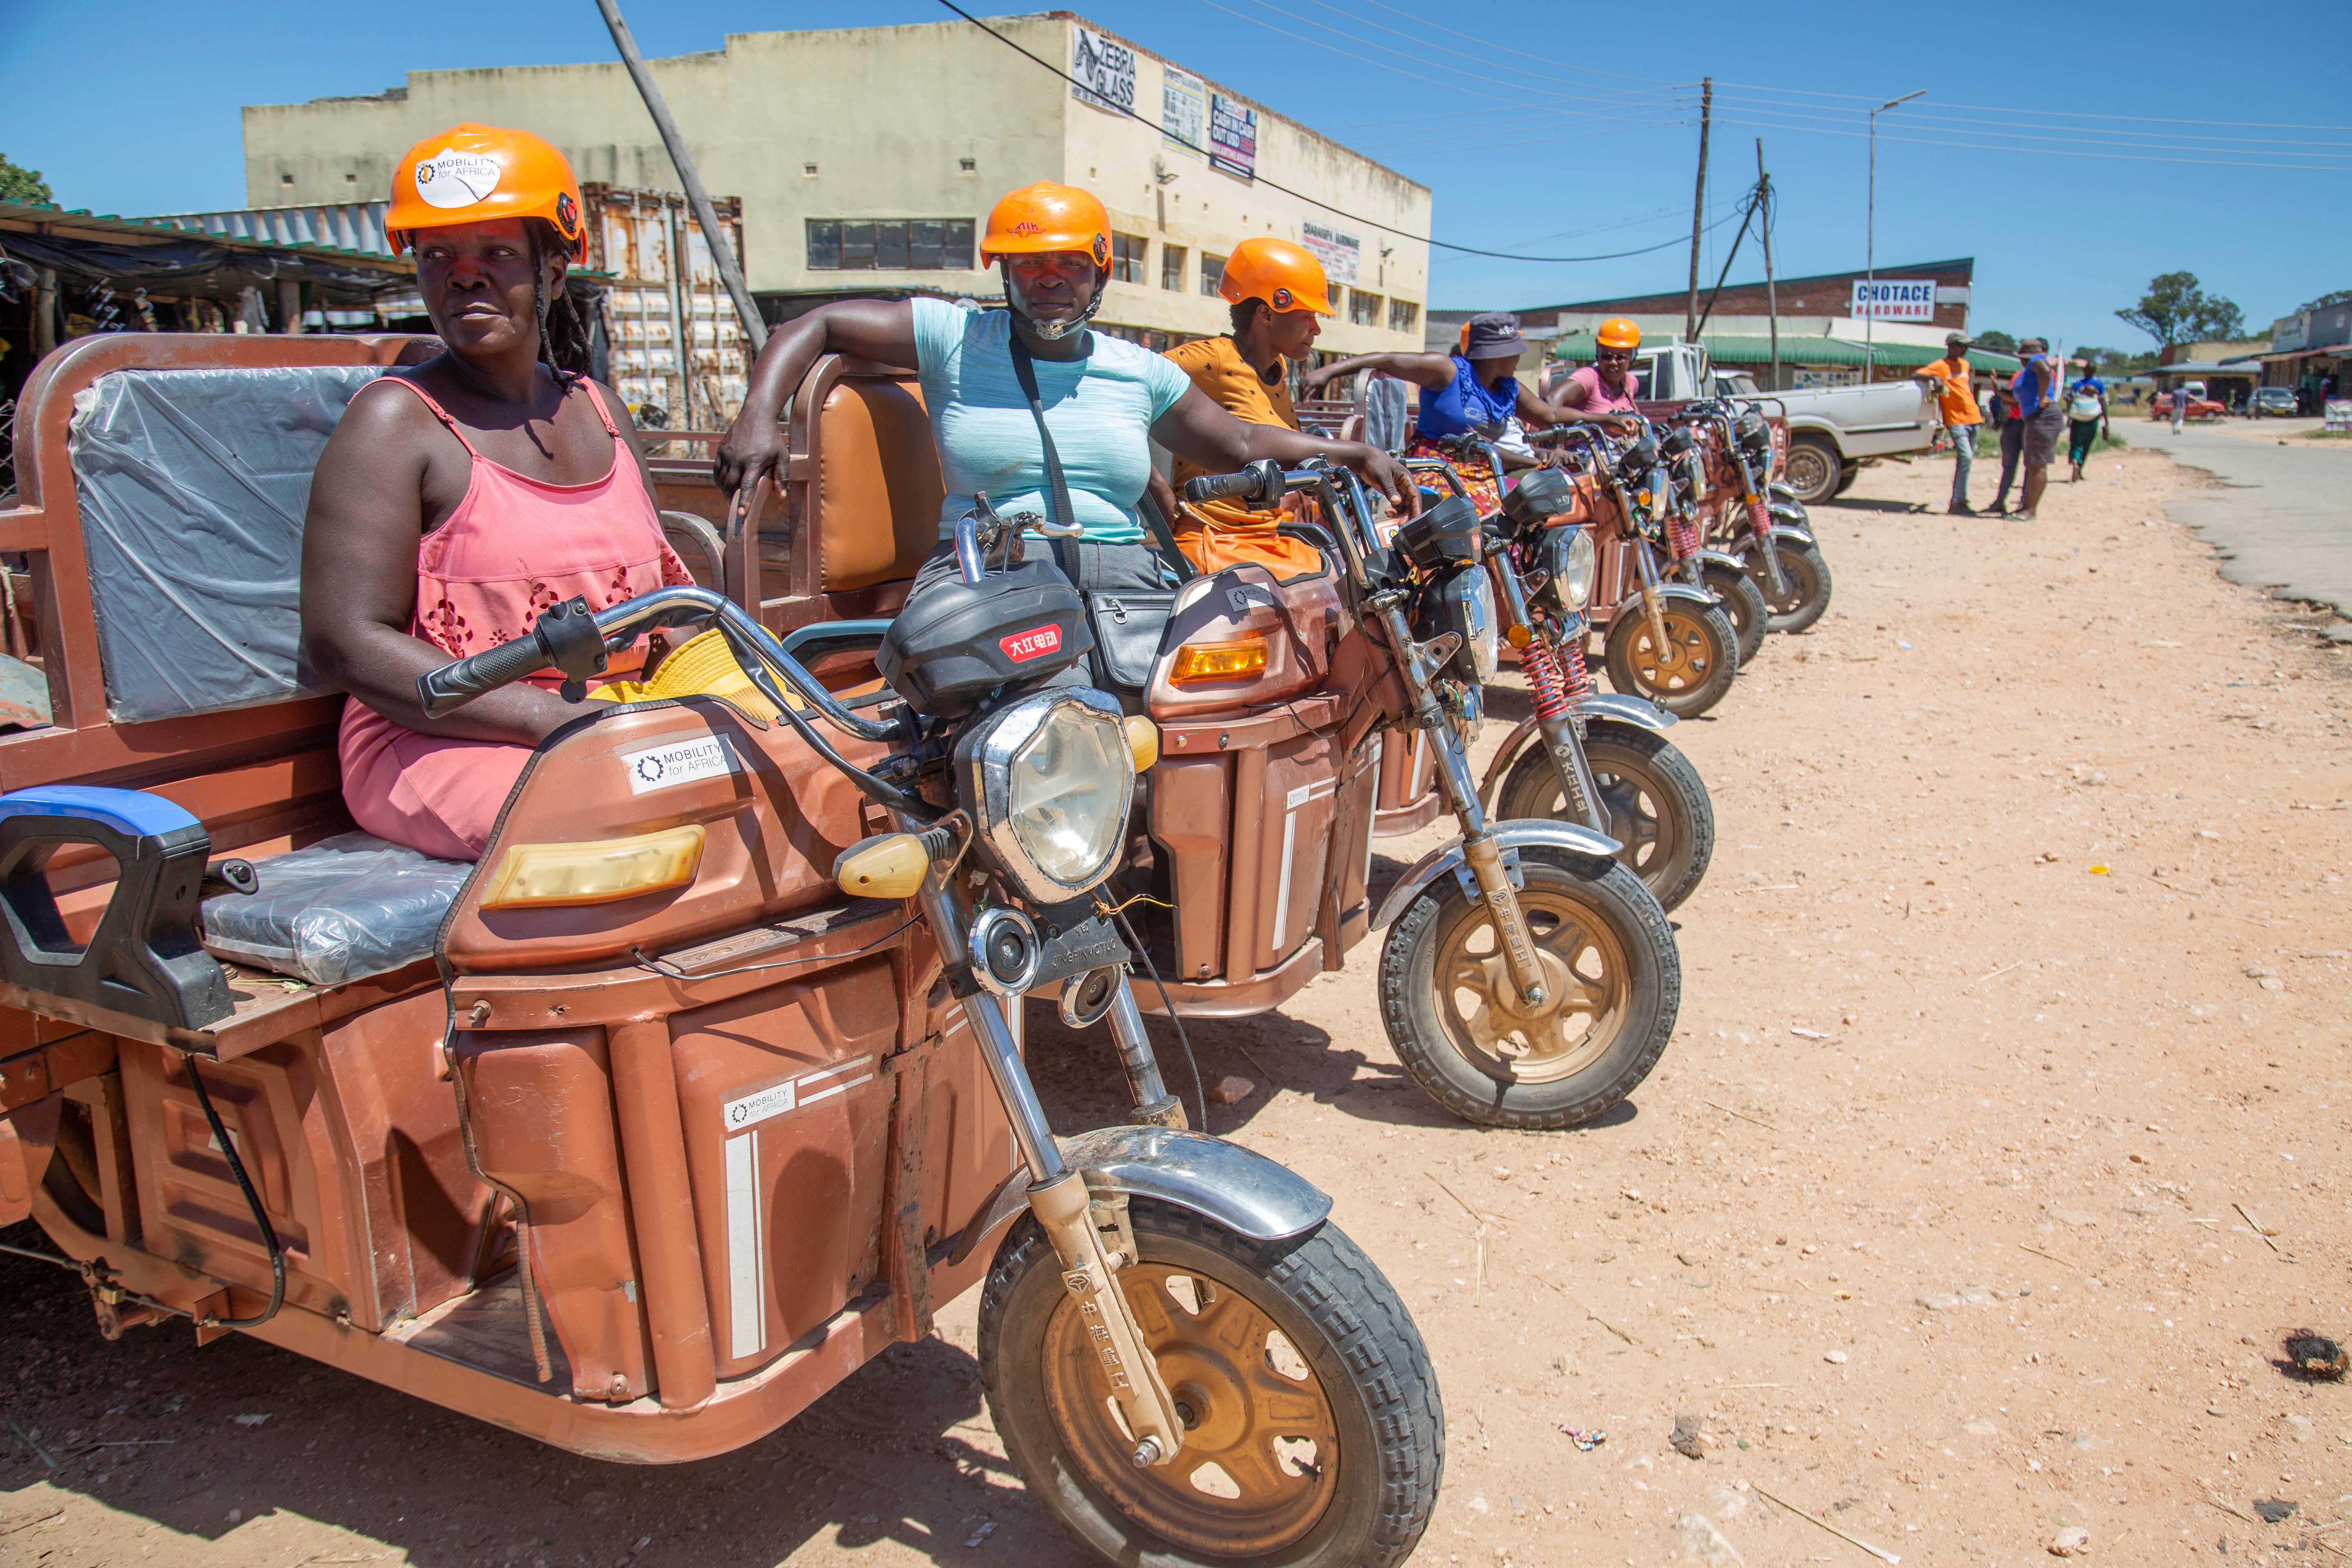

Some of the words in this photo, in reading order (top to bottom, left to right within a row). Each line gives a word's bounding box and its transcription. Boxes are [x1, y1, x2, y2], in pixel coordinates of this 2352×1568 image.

[1099, 39, 1136, 80] ZEBRA
[1096, 69, 1134, 105] GLASS
[1212, 124, 1225, 143] OUT
[1225, 129, 1240, 148] USD
[1213, 109, 1231, 129] CASH
[1232, 118, 1238, 133] IN
[1238, 122, 1255, 140] CASH
[439, 170, 451, 179] for
[455, 167, 495, 176] AFRICA
[1858, 286, 1931, 301] CHOTACE
[1856, 305, 1929, 316] HARDWARE
[1010, 631, 1058, 657] 大江电动
[664, 743, 721, 764] MOBILITY
[669, 766, 683, 776] for
[689, 755, 728, 772] AFRICA
[1562, 762, 1588, 812] 大江工业
[1499, 907, 1528, 961] 中海重工
[1051, 939, 1116, 968] JINGPINMOTUO
[749, 1089, 786, 1109] MOBILITY
[750, 1109, 760, 1118] for
[762, 1098, 788, 1114] AFRICA
[1082, 1301, 1129, 1388] 中海重工
